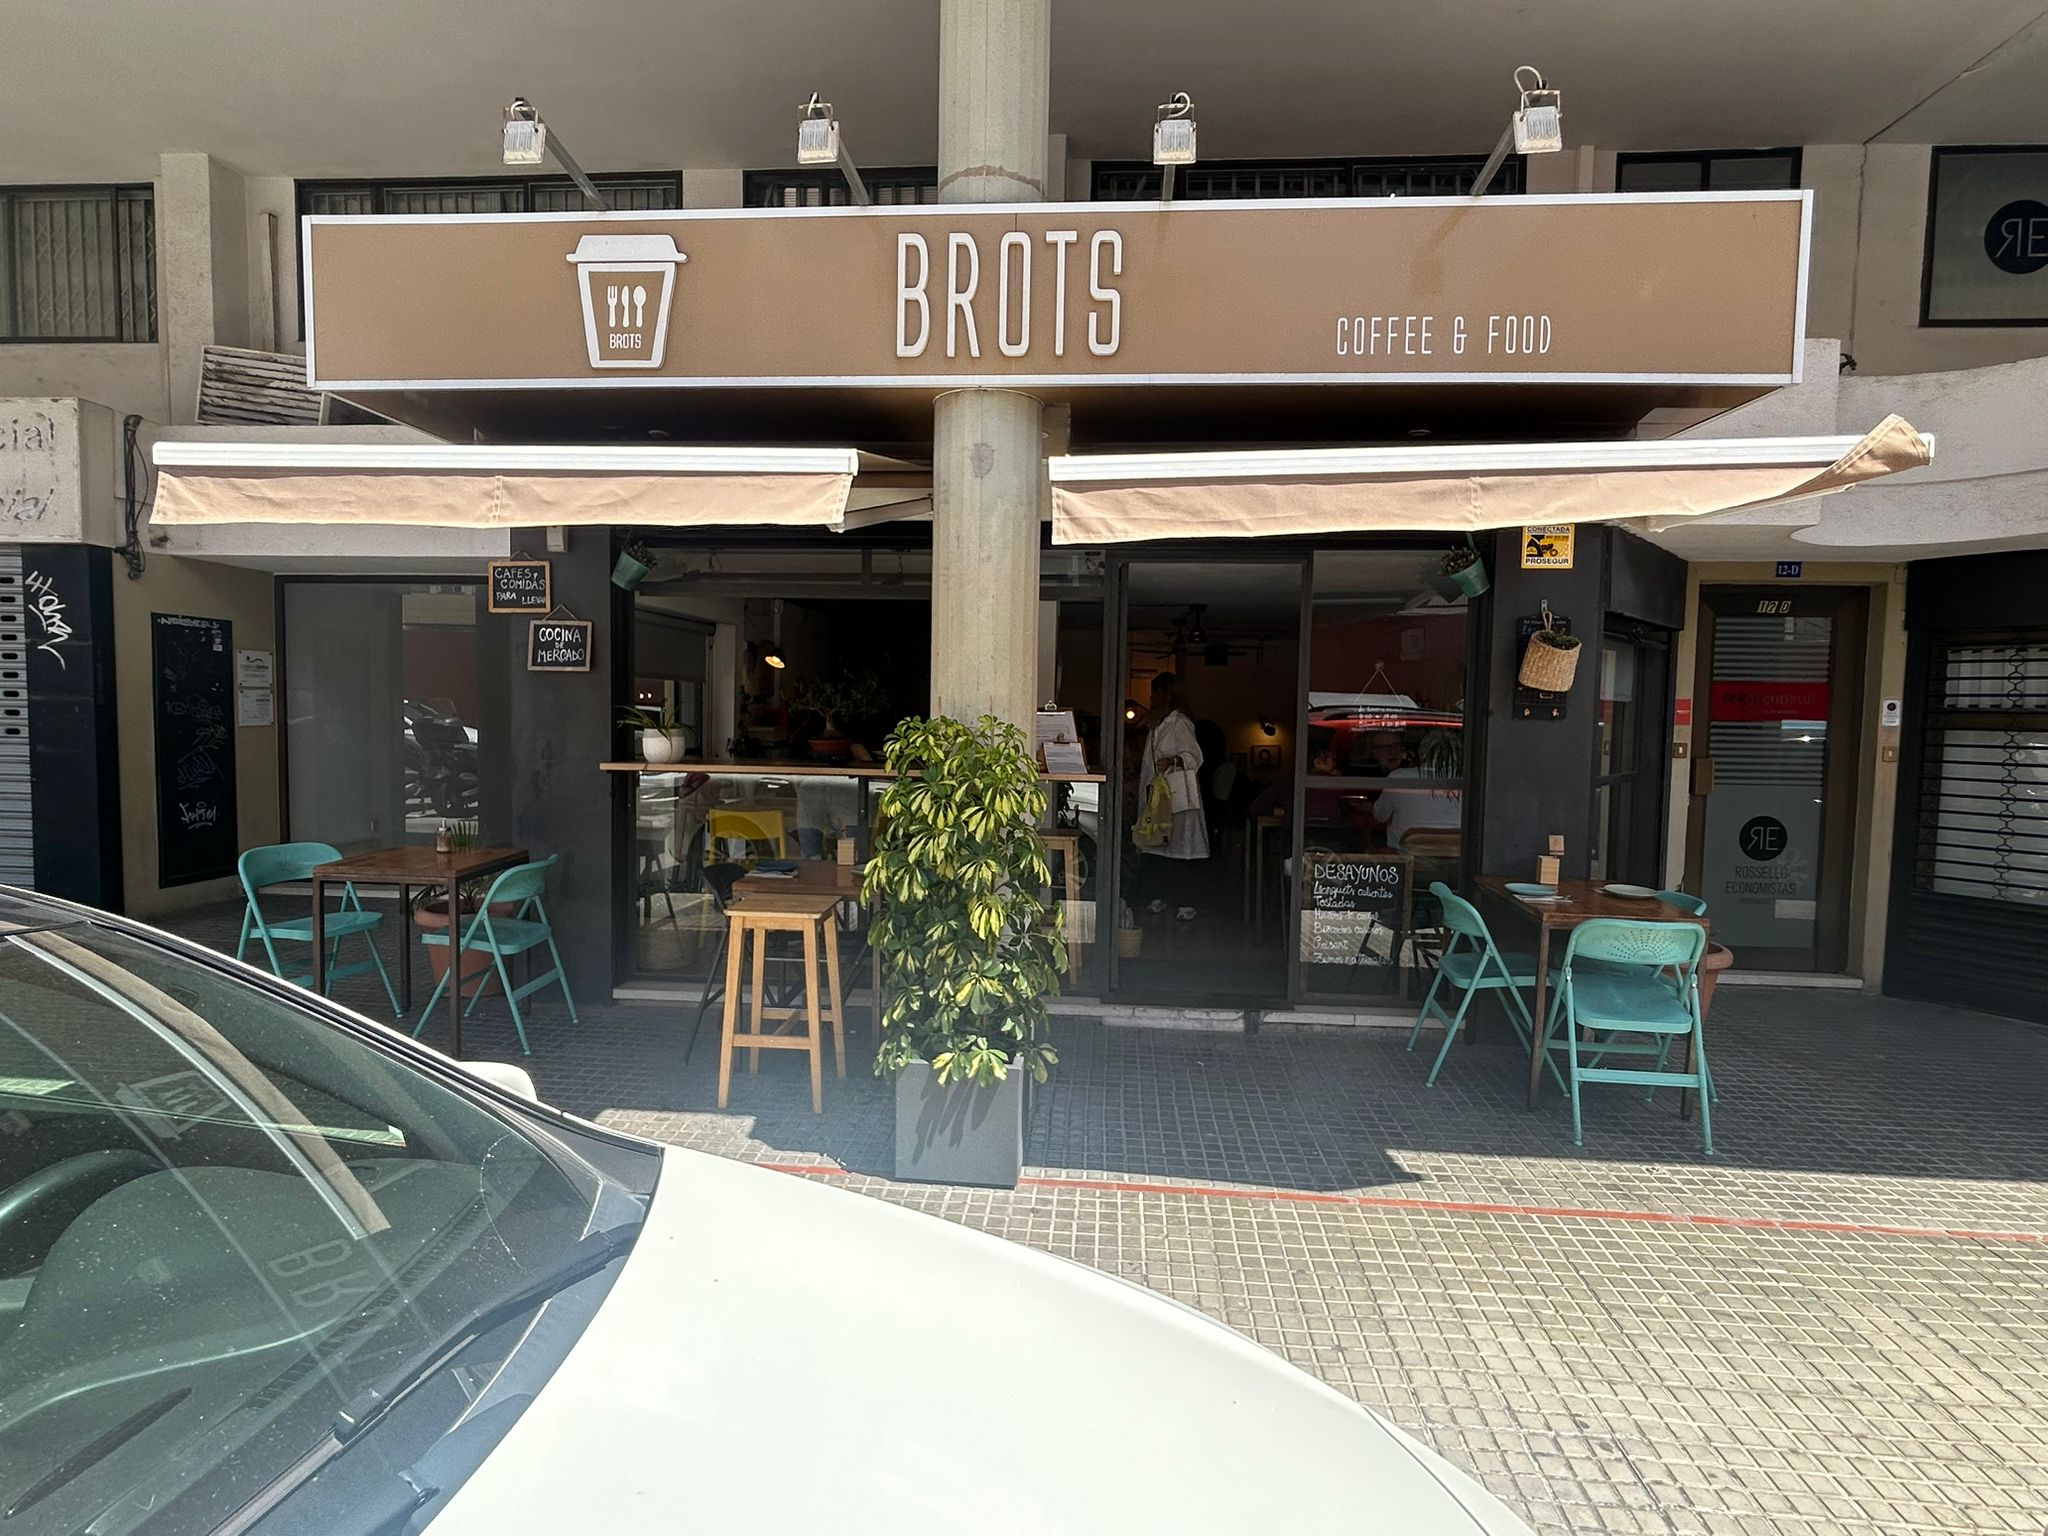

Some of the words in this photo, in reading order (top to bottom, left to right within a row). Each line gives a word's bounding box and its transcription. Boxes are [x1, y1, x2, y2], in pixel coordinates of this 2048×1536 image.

[896, 230, 1123, 358] BROTS
[608, 333, 642, 350] BROTS
[1336, 316, 1433, 355] COFFEE
[1453, 315, 1467, 354] &
[1488, 315, 1551, 354] FOOD
[494, 567, 532, 579] CAFES
[1778, 564, 1799, 575] 12-D
[500, 579, 546, 591] COMIDAS
[496, 591, 517, 601] PARA
[1756, 600, 1778, 614] 12
[538, 626, 582, 643] COCINA
[554, 641, 565, 649] DE
[537, 648, 585, 663] MERCADO
[1314, 863, 1399, 885] DESAYUNOS
[1724, 881, 1797, 896] ECONOMISTAS
